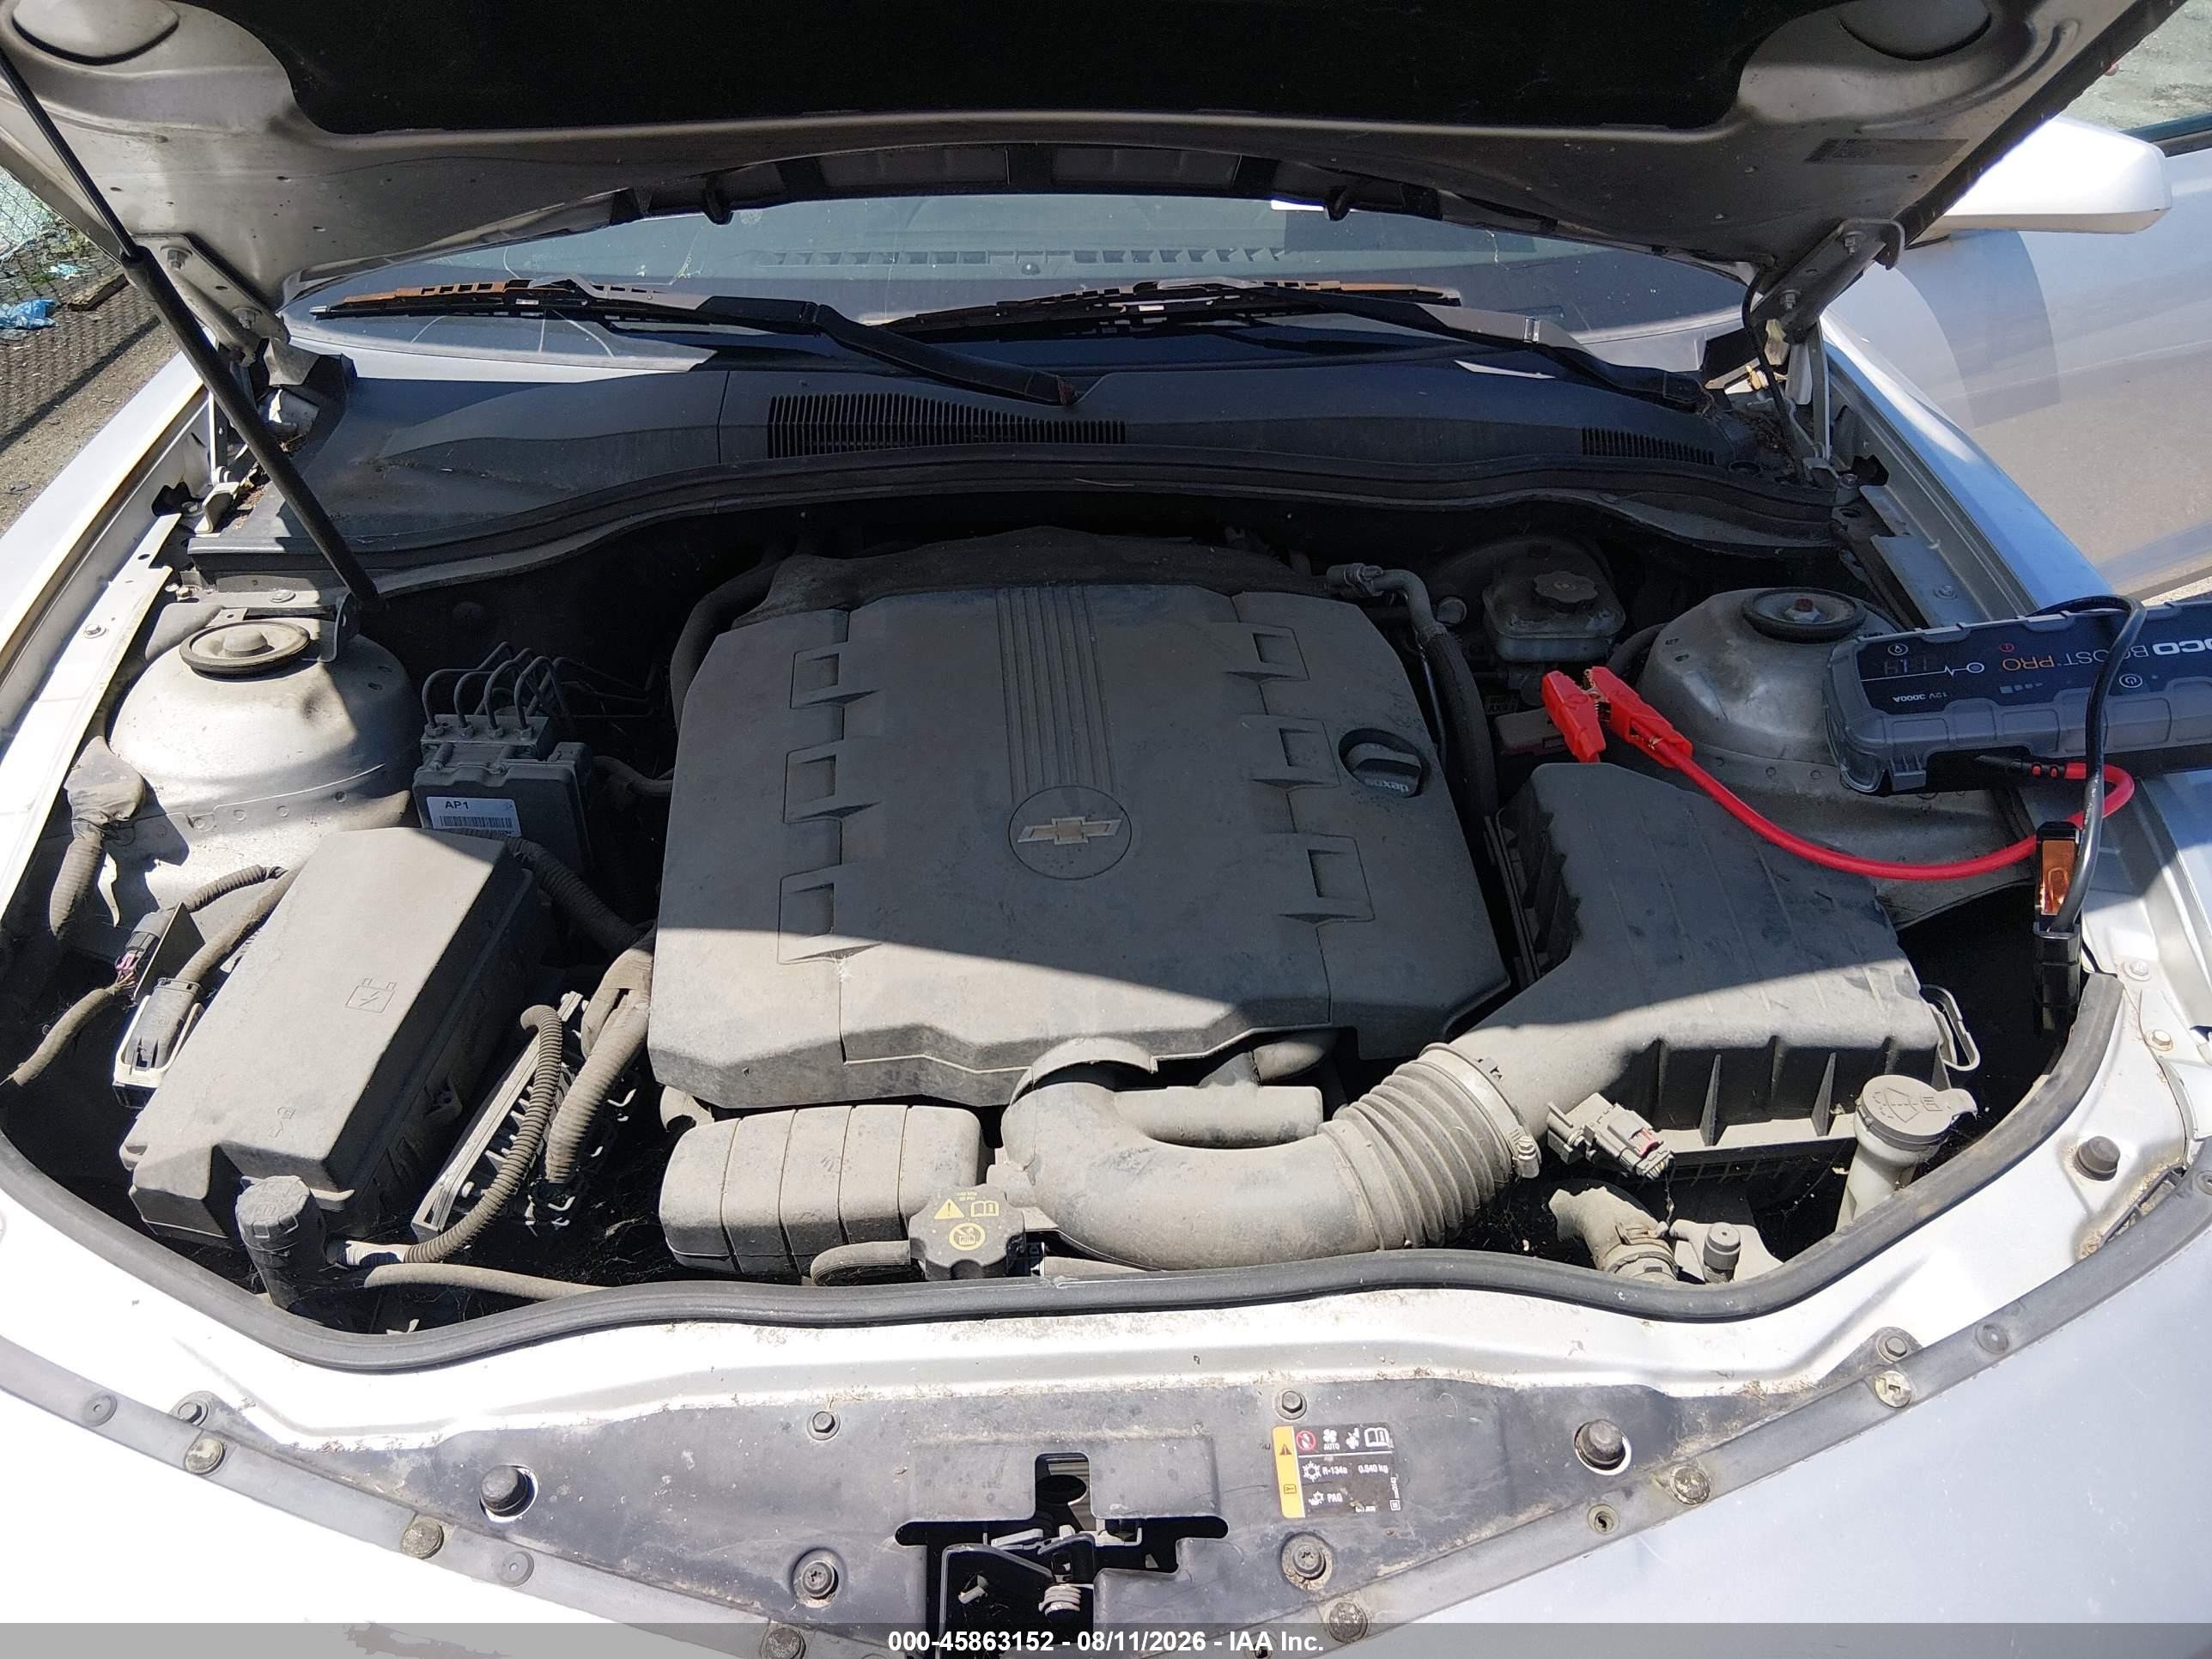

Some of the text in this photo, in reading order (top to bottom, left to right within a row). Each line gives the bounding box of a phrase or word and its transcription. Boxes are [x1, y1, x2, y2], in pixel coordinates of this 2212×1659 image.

[2152, 638, 2212, 655] CO
[2002, 655, 2055, 671] PRO
[445, 800, 469, 810] AP1
[1323, 1443, 1340, 1451] AUTO
[1322, 1464, 1348, 1475] R-134a
